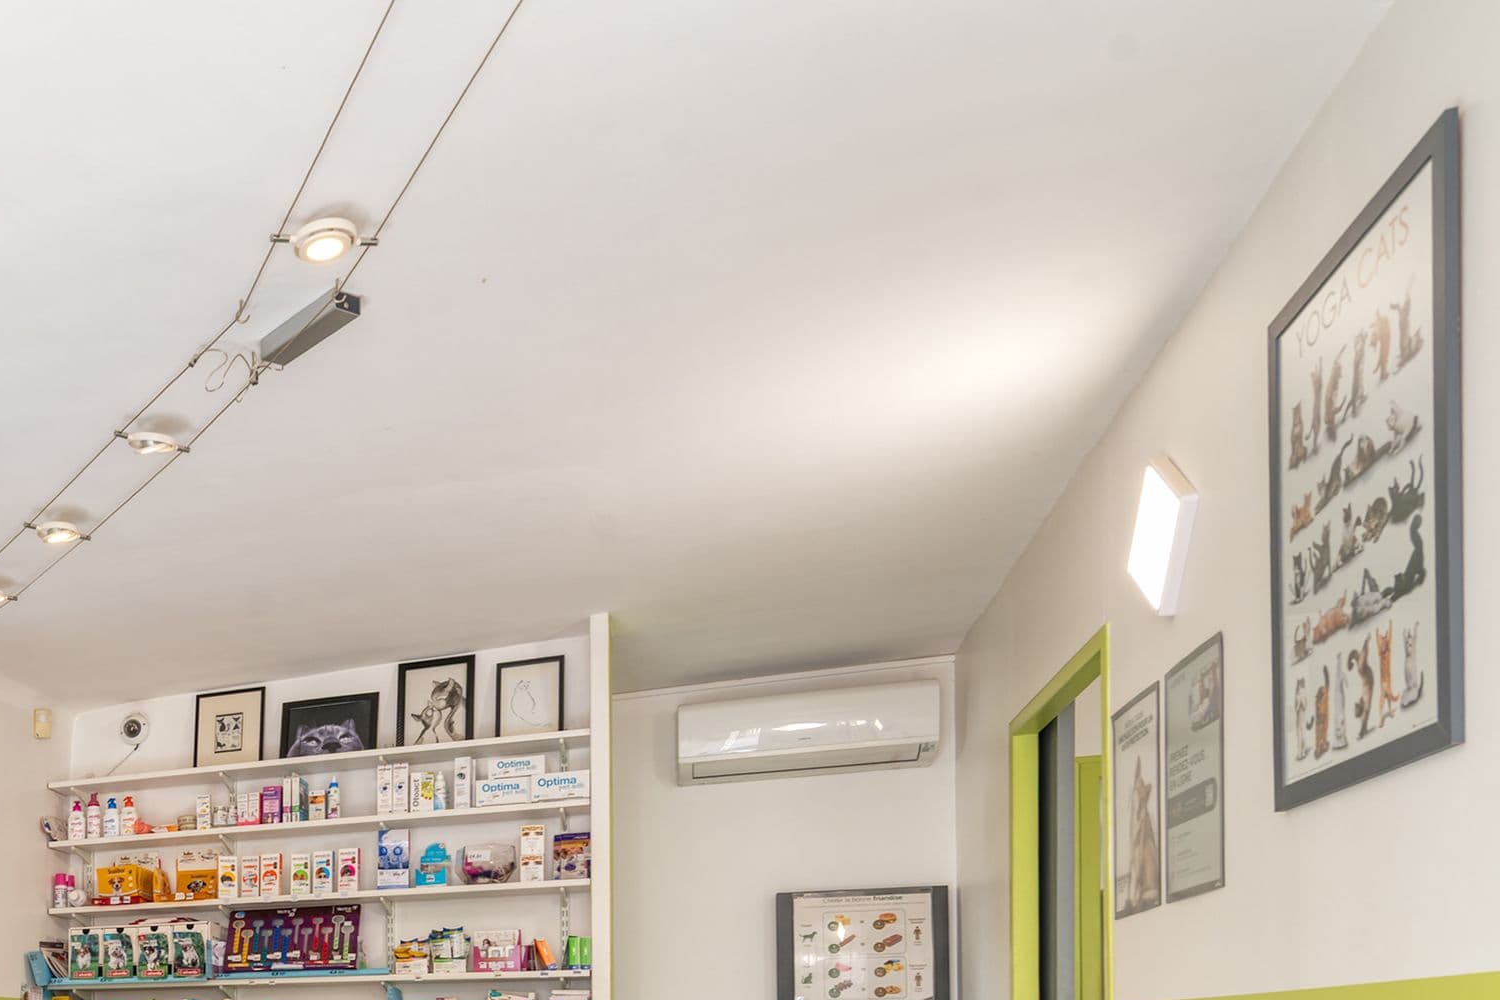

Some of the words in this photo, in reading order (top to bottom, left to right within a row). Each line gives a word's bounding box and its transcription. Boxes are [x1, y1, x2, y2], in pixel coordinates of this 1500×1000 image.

[1296, 273, 1351, 358] YOGA
[1357, 205, 1409, 288] CATS
[497, 759, 531, 771] Optima
[482, 782, 520, 793] Optima
[538, 776, 577, 788] Optima
